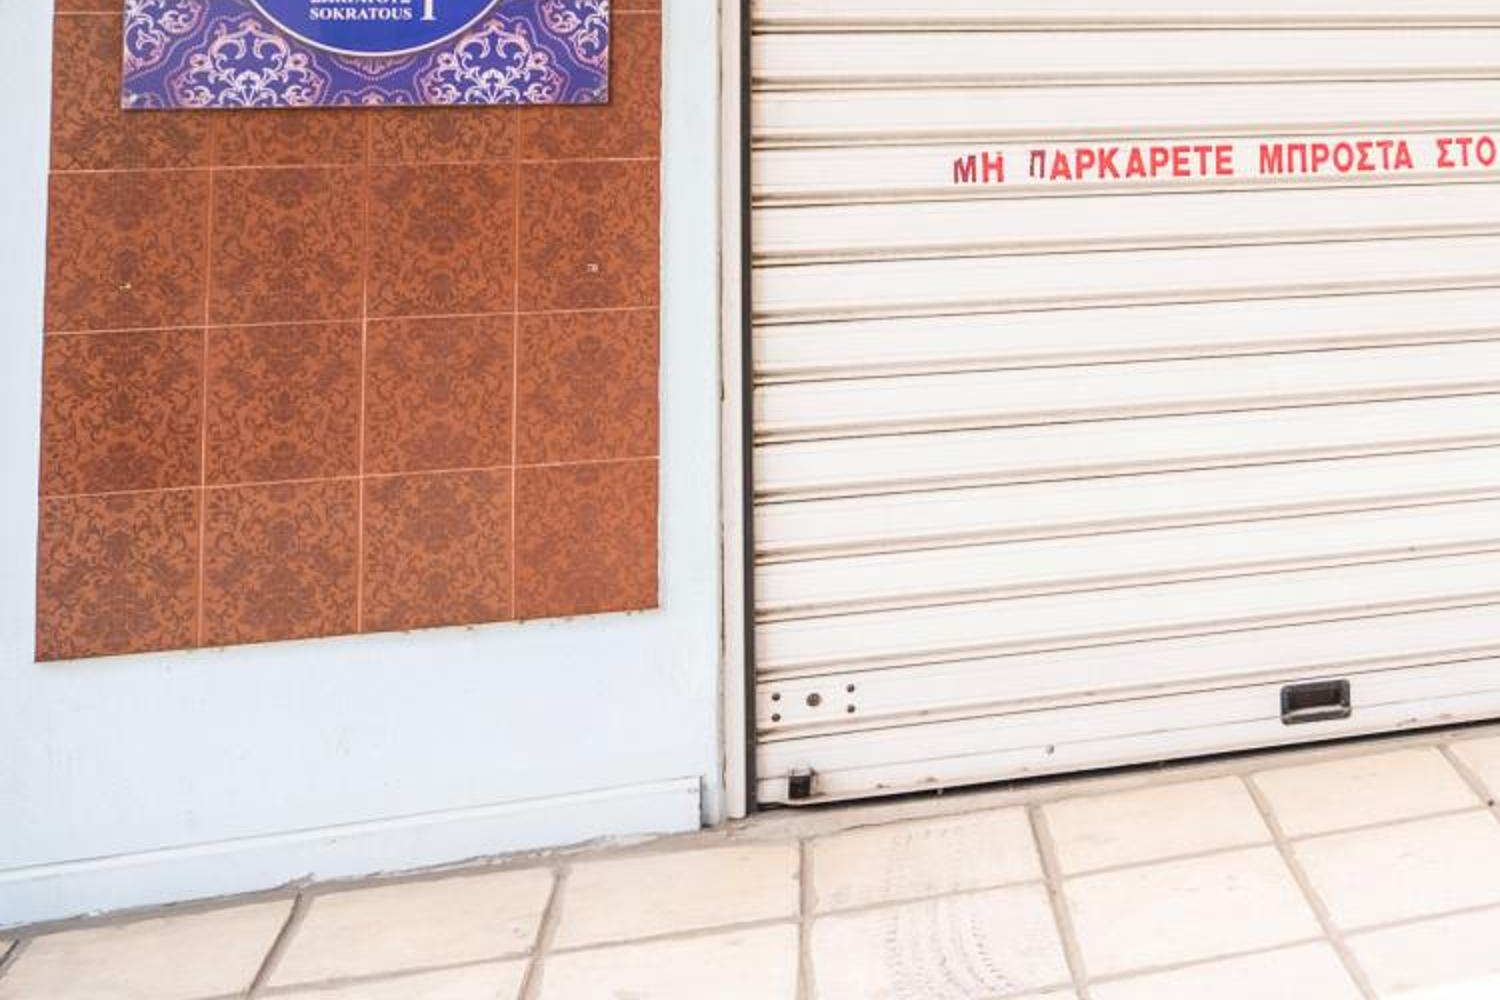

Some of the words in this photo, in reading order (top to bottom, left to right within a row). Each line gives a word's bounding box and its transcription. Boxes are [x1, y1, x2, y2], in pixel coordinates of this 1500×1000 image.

[309, 7, 412, 21] SOKRATOUS
[1029, 144, 1234, 181] ΠΑΡΚΑΡΕΤΕ
[1259, 139, 1414, 175] ΜΠΡΟΣΤΑ
[1436, 135, 1497, 168] ΣΤΟ
